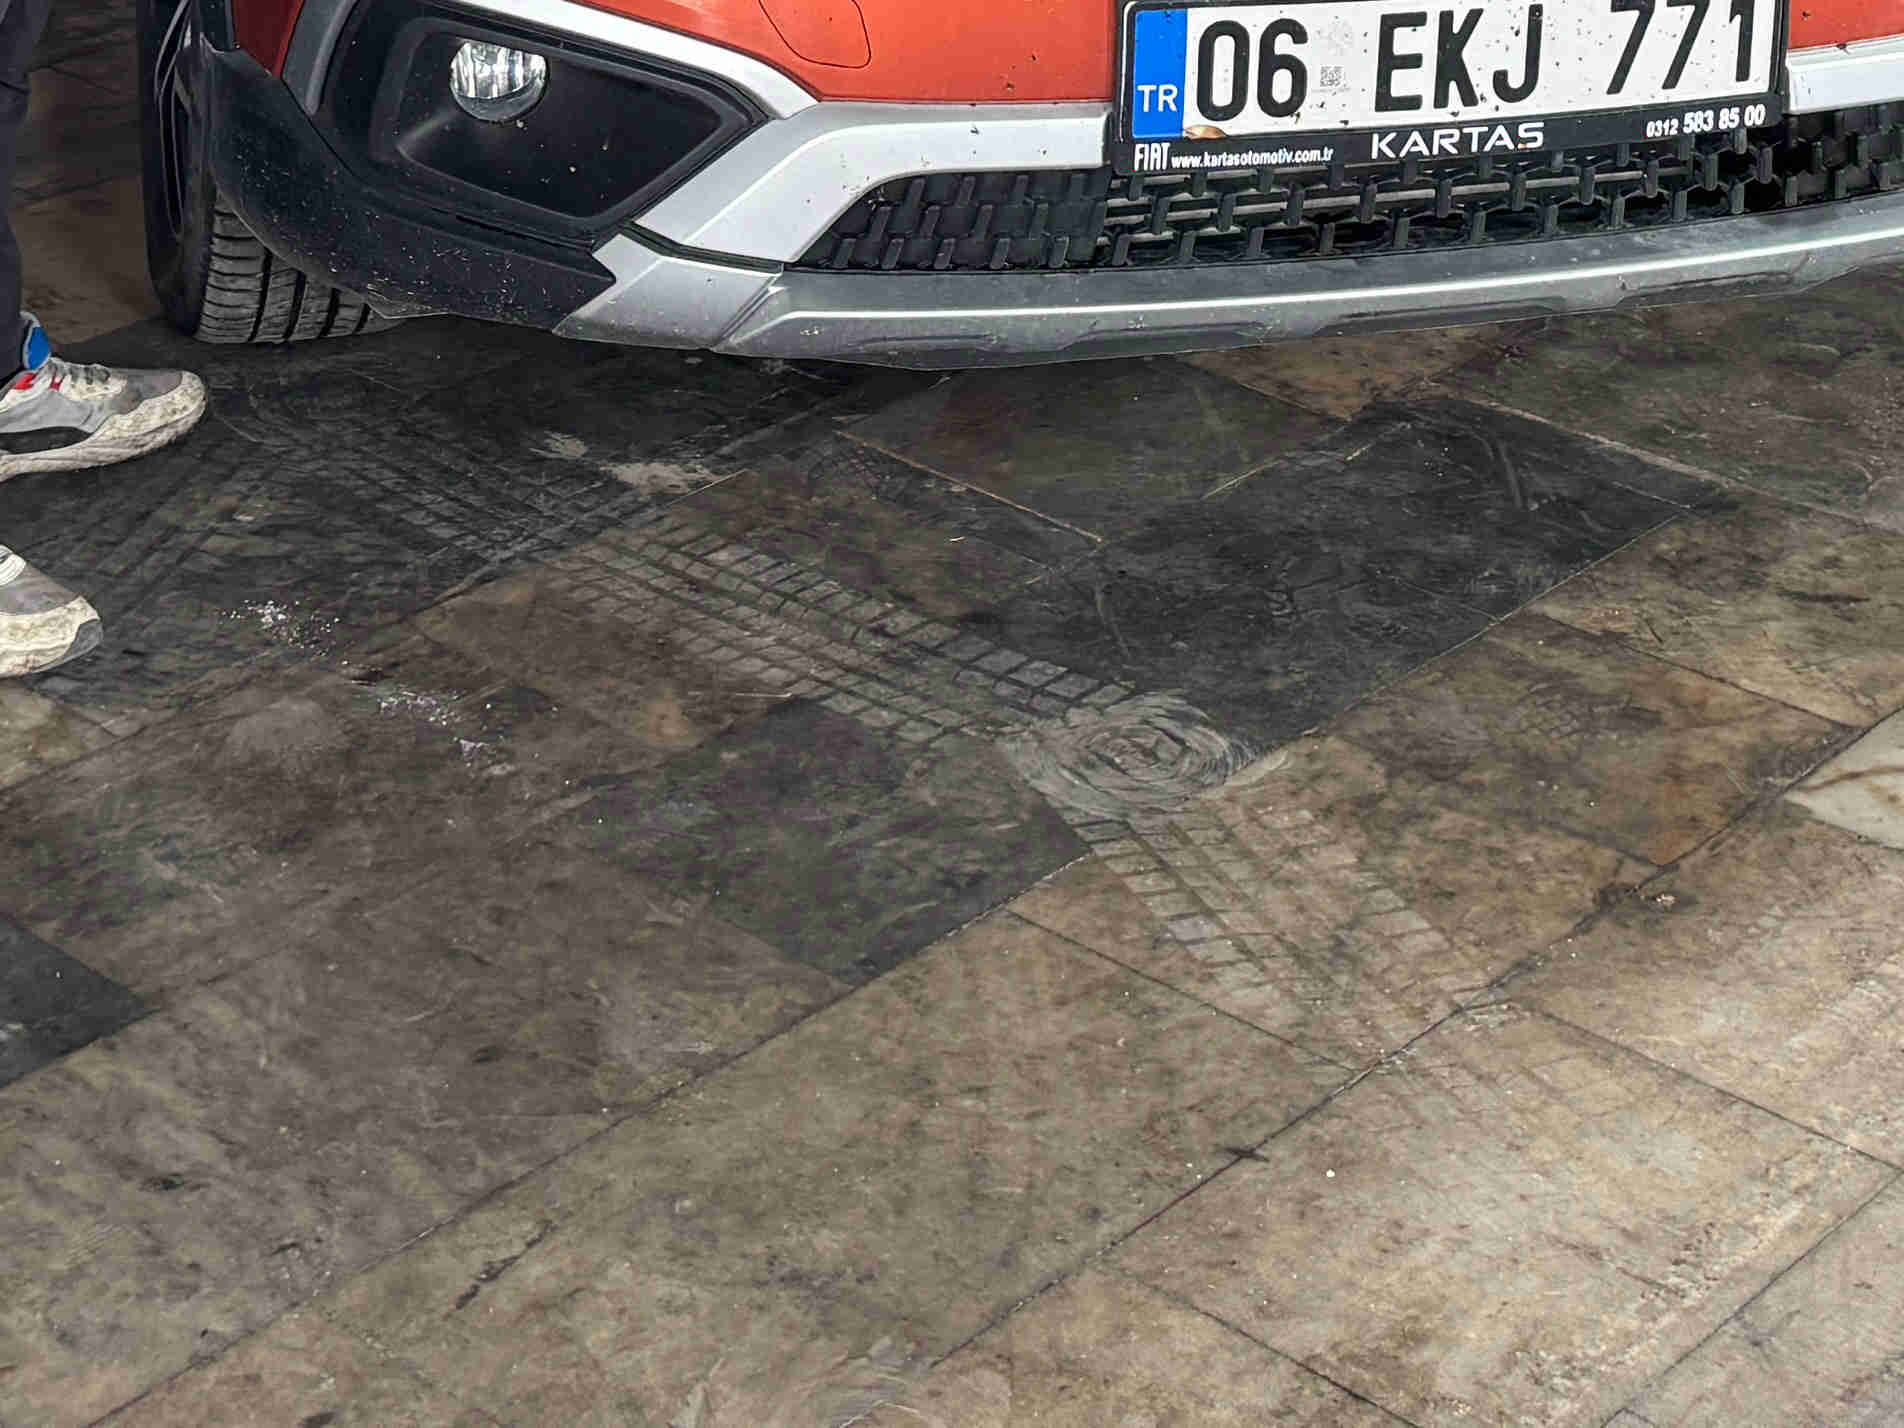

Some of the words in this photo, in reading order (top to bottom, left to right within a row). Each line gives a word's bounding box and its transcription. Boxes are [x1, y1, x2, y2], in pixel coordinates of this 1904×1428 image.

[1196, 18, 1309, 122] 06
[1373, 3, 1544, 114] EKJ
[1137, 84, 1178, 113] TR
[1646, 120, 1679, 138] 0312
[1718, 107, 1741, 130] 85
[1744, 104, 1766, 127] 00
[1134, 143, 1171, 171] FIAT
